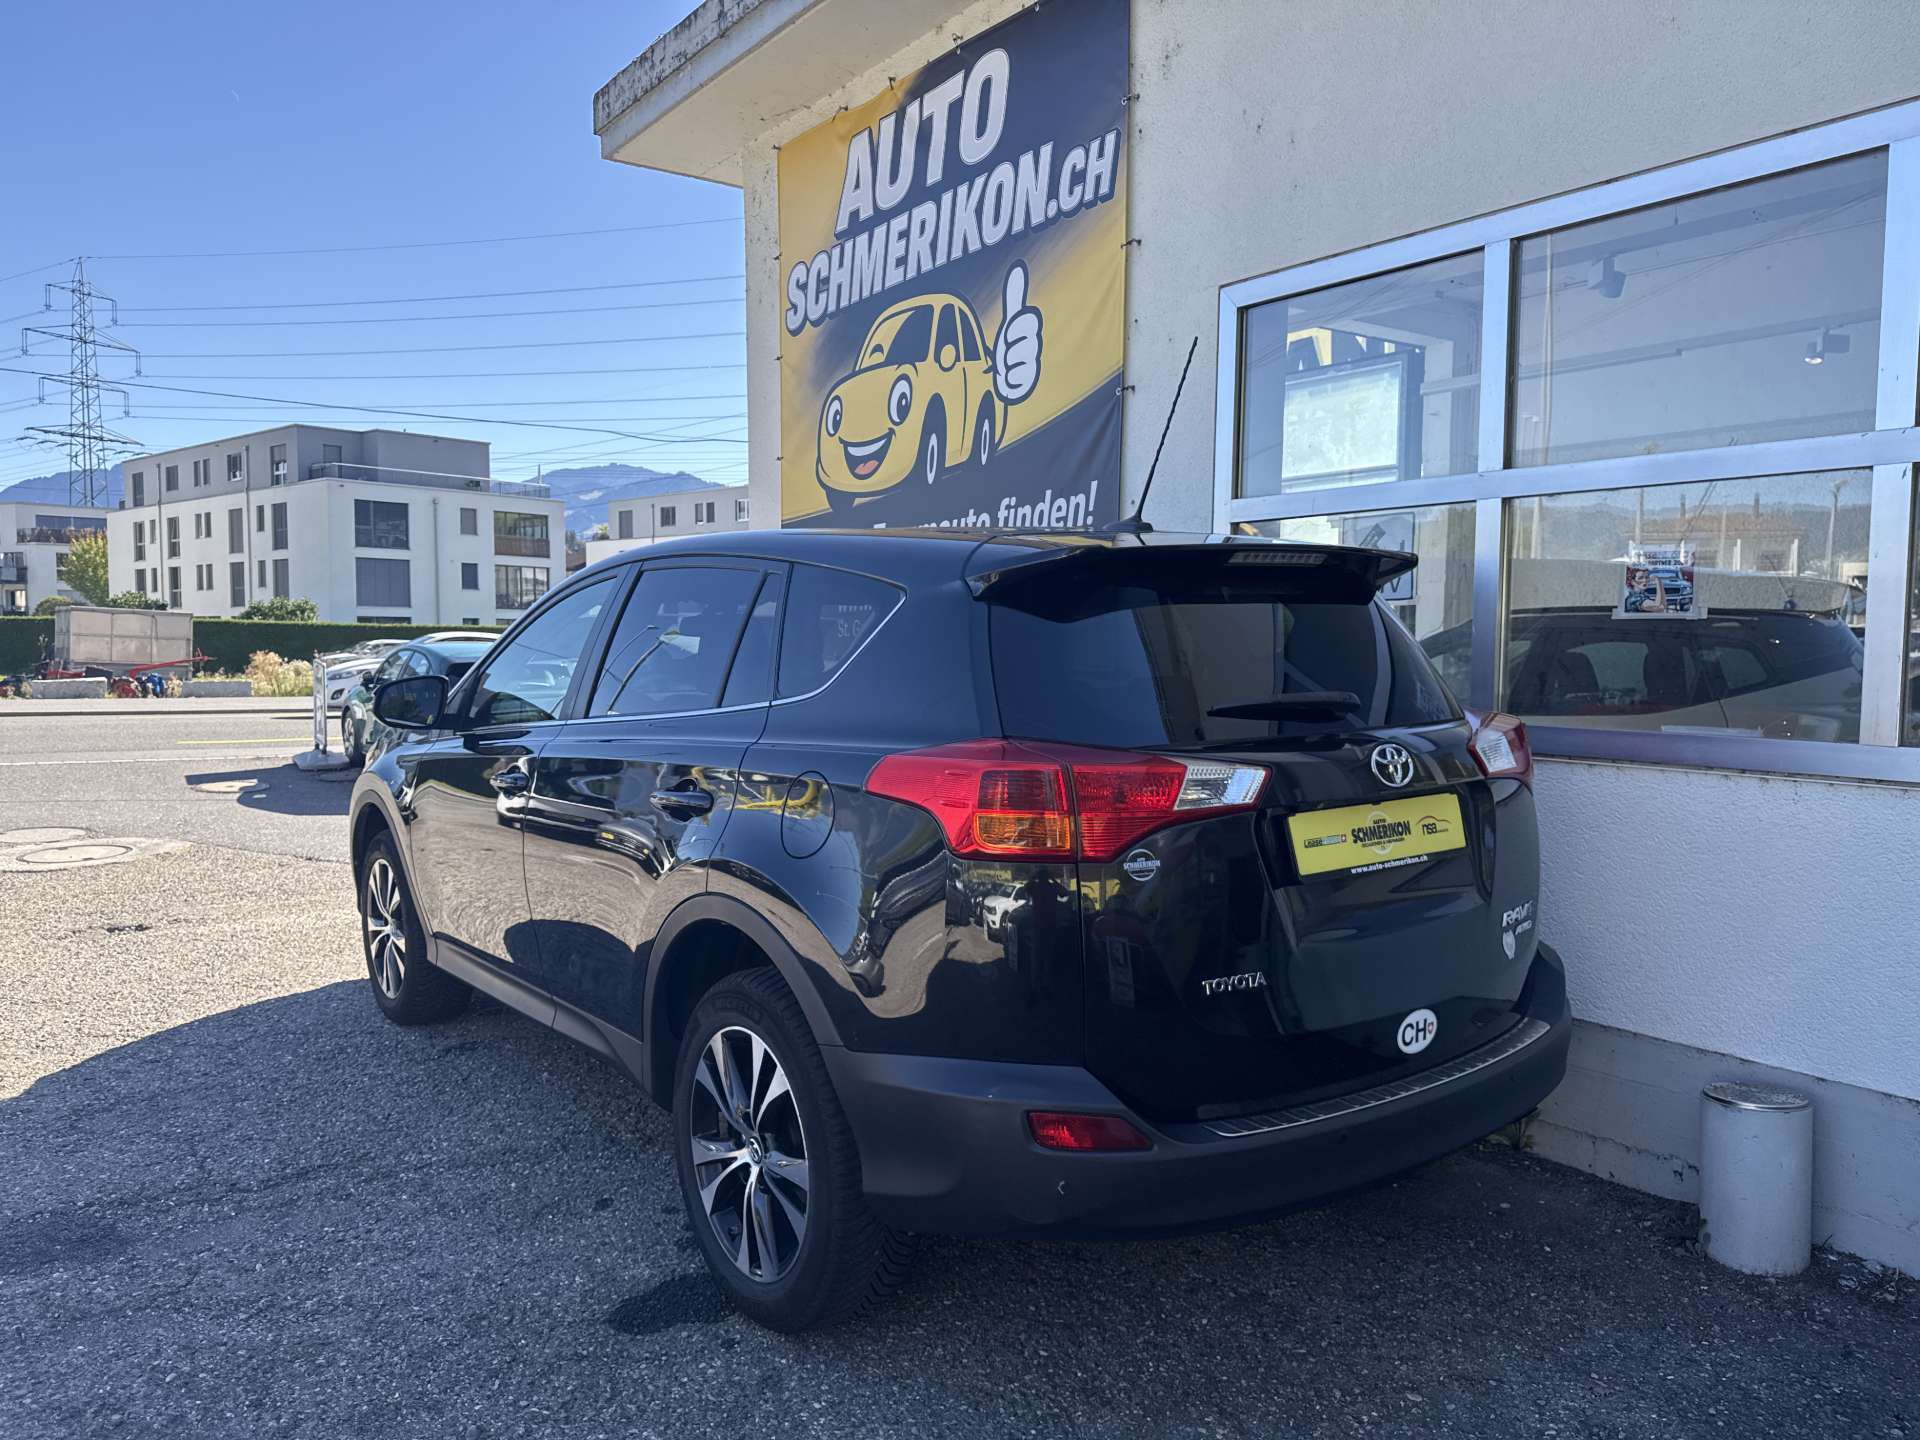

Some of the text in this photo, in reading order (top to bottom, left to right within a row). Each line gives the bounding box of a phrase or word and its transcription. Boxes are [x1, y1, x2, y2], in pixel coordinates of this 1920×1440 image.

[836, 48, 1010, 234] AUTO
[785, 129, 1121, 333] SCHMERIKON.CH
[998, 480, 1098, 529] finden!
[1351, 820, 1411, 844] SCHMERIKON
[1123, 860, 1160, 870] SCHMERIKON
[1351, 855, 1428, 874] www.auto-schmerikon.ch
[1201, 971, 1267, 996] TOYOTA
[1402, 1018, 1427, 1047] CH
